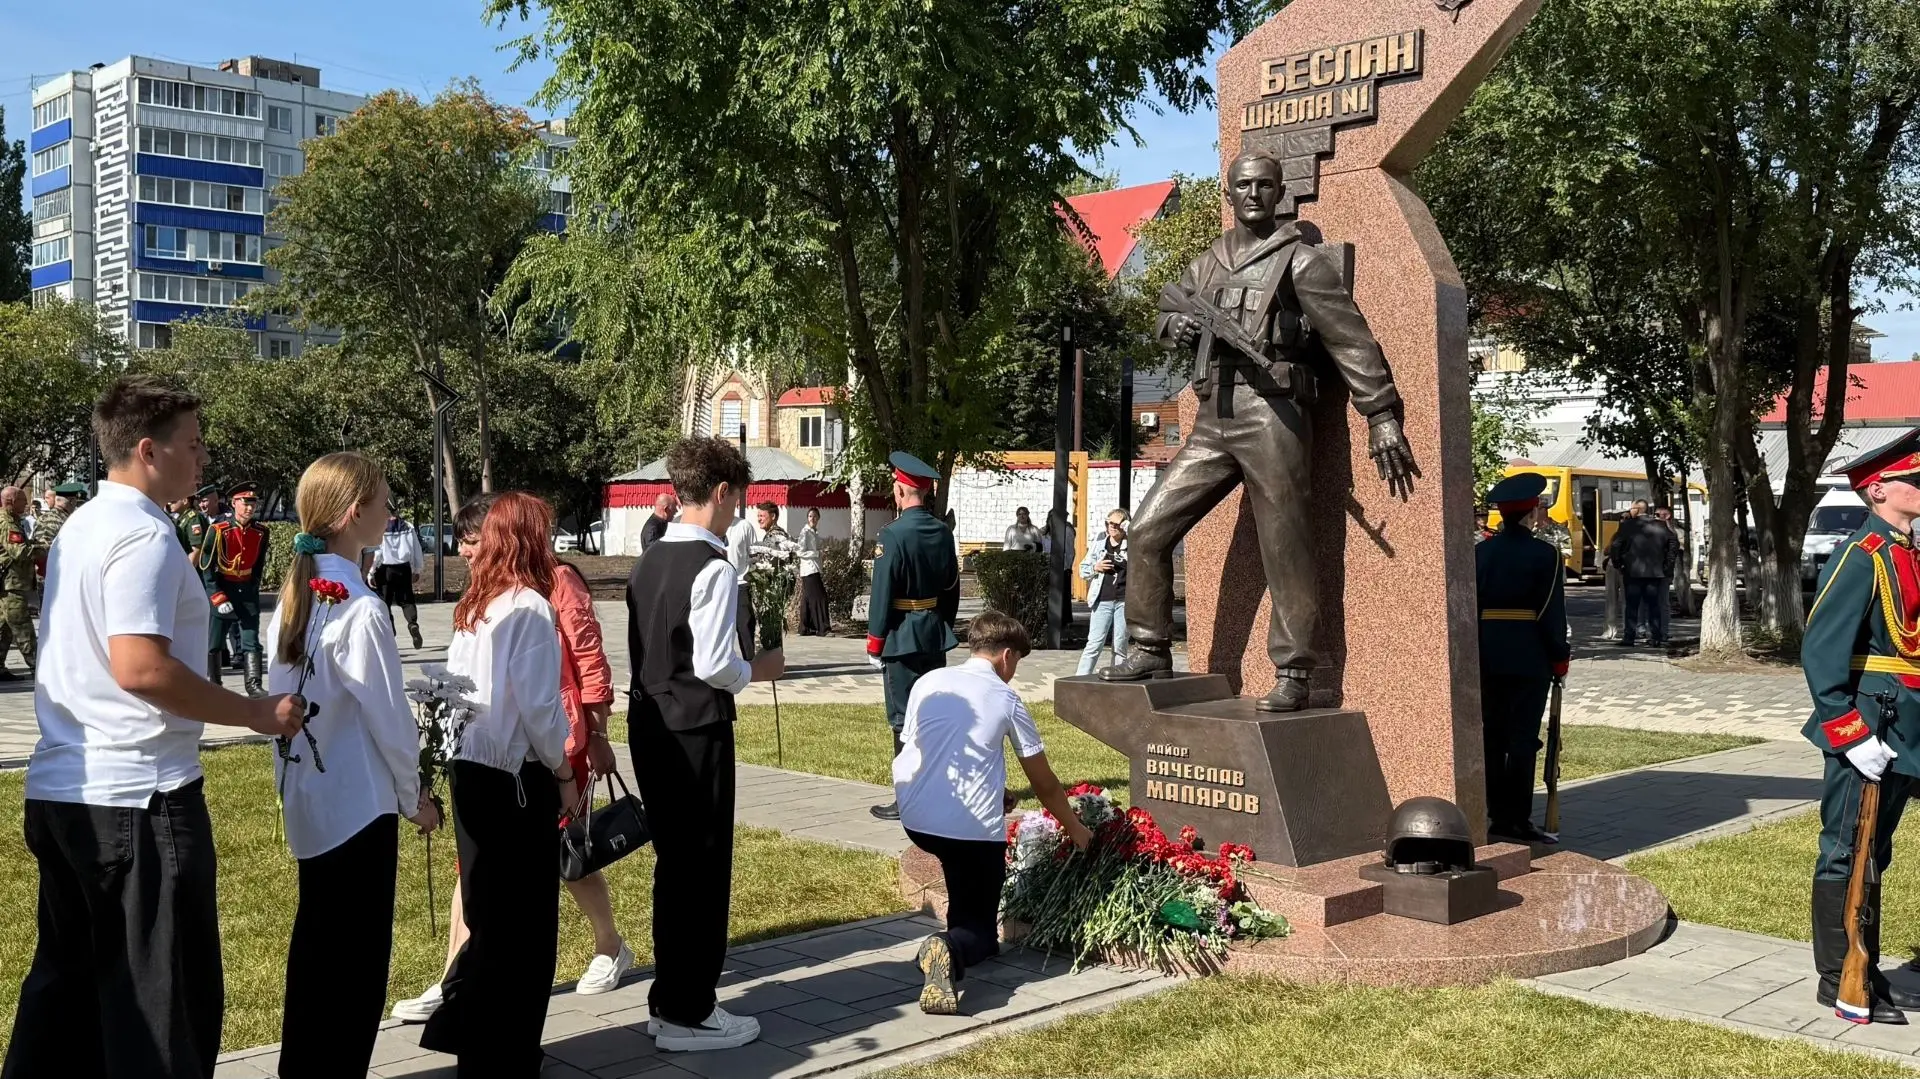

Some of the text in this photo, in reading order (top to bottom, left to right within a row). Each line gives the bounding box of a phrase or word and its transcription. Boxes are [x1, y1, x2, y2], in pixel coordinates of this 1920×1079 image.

[1261, 32, 1416, 98] БЕСЛАН
[1241, 91, 1334, 131] ШКОЛА
[1147, 743, 1189, 758] МАЙОР
[1146, 759, 1245, 786] ВЯЧЕСЛАВ
[1146, 780, 1260, 815] МАЛЯРОВ
